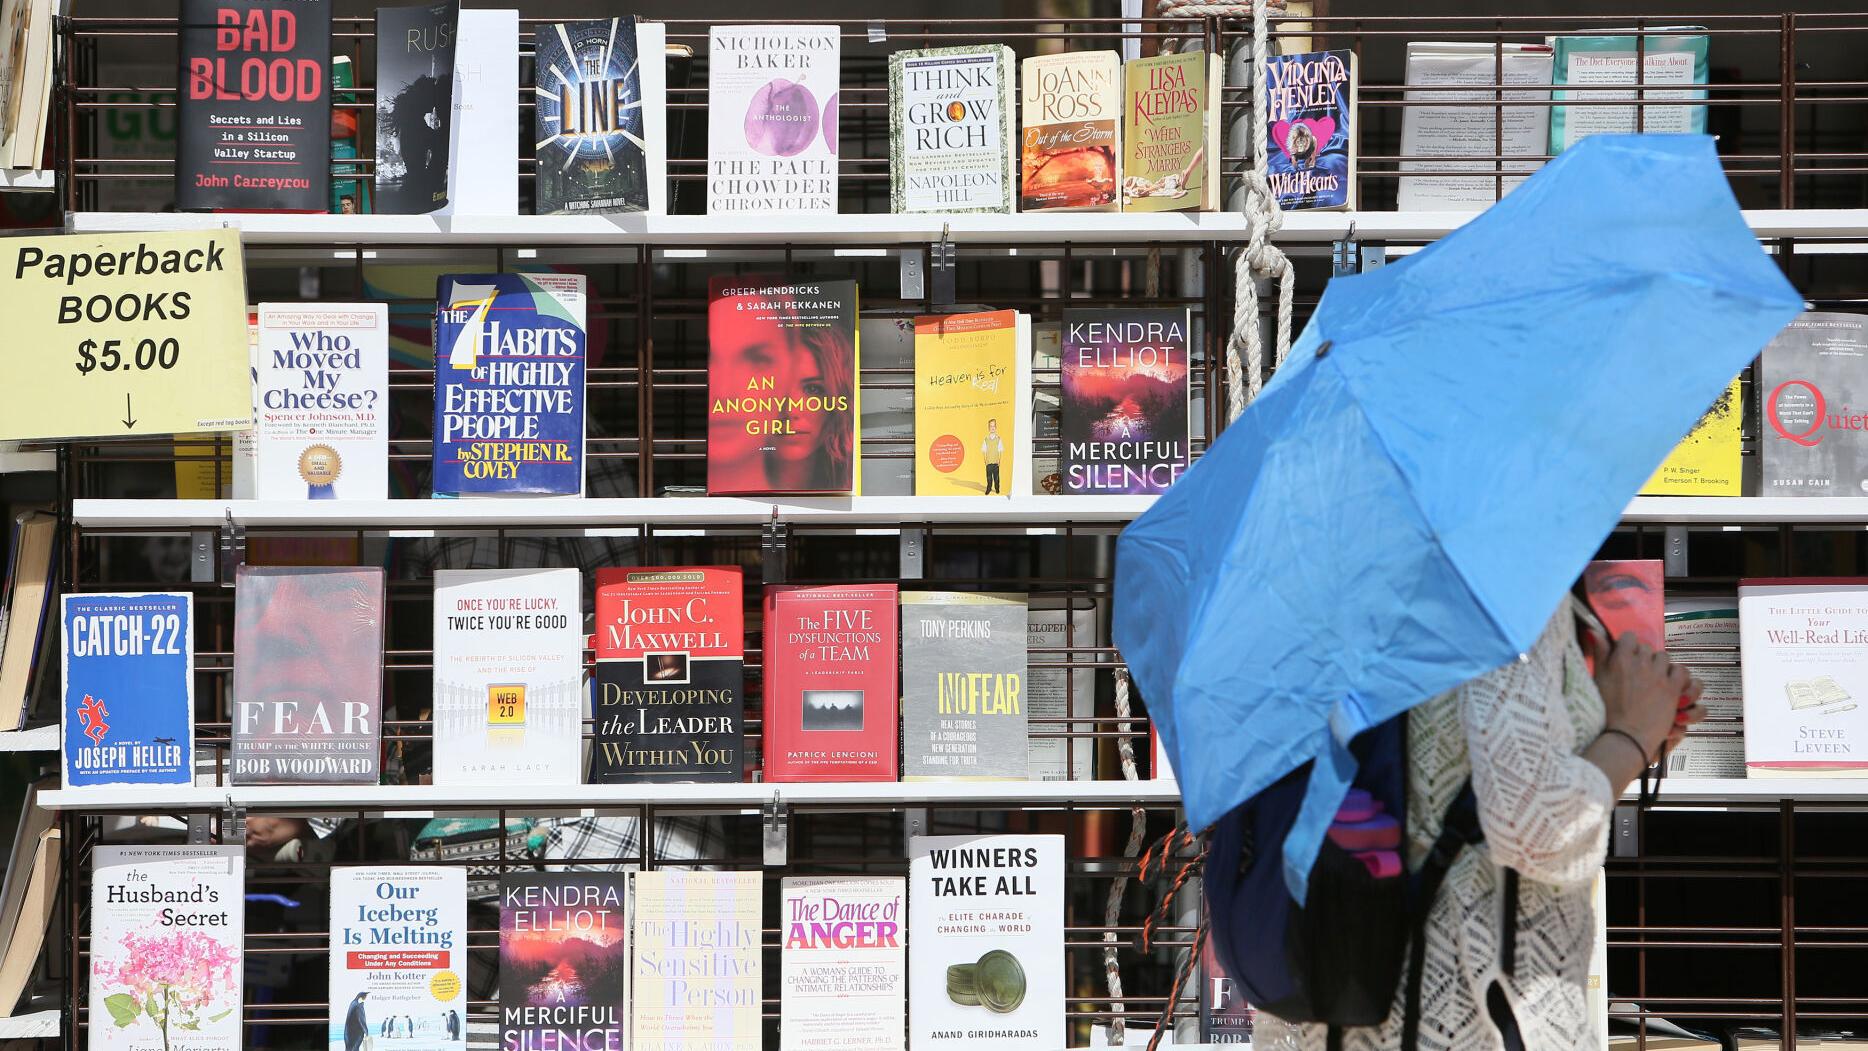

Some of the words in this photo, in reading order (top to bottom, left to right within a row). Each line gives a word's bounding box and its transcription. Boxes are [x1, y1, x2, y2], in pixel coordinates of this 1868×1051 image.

[217, 9, 296, 52] BAD
[715, 37, 834, 50] NICHOLSON
[738, 54, 811, 68] BAKER
[190, 57, 322, 102] BLOOD
[907, 67, 993, 91] THINK
[1150, 65, 1186, 91] LISA
[559, 77, 626, 136] LINE
[908, 99, 993, 125] GROW
[1134, 87, 1198, 127] KLEYPAS
[210, 114, 251, 125] Secrets
[256, 116, 274, 125] and
[278, 116, 302, 126] Lies
[753, 114, 811, 122] ANTHOLOGIST
[221, 132, 234, 142] in
[237, 134, 244, 142] a
[247, 131, 289, 142] Silicon
[916, 124, 989, 150] RICH
[1025, 127, 1048, 148] Out
[1048, 131, 1061, 149] of
[1060, 129, 1072, 143] the
[1072, 122, 1114, 143] Storm
[214, 148, 249, 160] Valley
[253, 149, 296, 160] Startup
[195, 174, 229, 188] John
[233, 174, 310, 190] Carreyrou
[910, 171, 997, 189] NAPOLEON
[1268, 171, 1299, 198] Wild
[1299, 170, 1339, 194] Hearts
[712, 198, 831, 210] CHRONICLES
[936, 188, 973, 203] HILL
[15, 240, 225, 285] Paperback
[722, 287, 756, 296] GREER
[759, 286, 820, 295] HENDRICKS
[57, 291, 192, 324] BOOKS
[442, 310, 468, 324] THE
[449, 280, 499, 369] 7
[1070, 321, 1183, 344] KENDRA
[290, 330, 351, 351] Who
[476, 320, 577, 356] HABITS
[75, 337, 180, 376] $5.00
[272, 348, 361, 369] Moved
[1079, 346, 1175, 368] ELLIOT
[303, 370, 341, 393] My
[471, 365, 489, 380] OF
[489, 362, 575, 386] HIGHLY
[746, 376, 775, 391] AN
[930, 373, 972, 386] Heaven
[976, 368, 985, 380] is
[989, 364, 1007, 378] for
[263, 388, 378, 409] Cheese?
[443, 383, 573, 414] EFFECTIVE
[711, 395, 848, 414] ANONYMOUS
[264, 412, 305, 422] Spencer
[307, 412, 353, 422] Johnson,
[355, 412, 377, 421] M.D.
[1767, 379, 1868, 447] Quiet
[442, 414, 540, 443] PEOPLE
[745, 419, 797, 436] GIRL
[1070, 441, 1185, 460] MERCIFUL
[1700, 477, 1729, 486] Brooking
[1808, 478, 1830, 486] CAIN
[457, 599, 483, 611] ONCE
[486, 598, 521, 610] YOU'RE
[525, 598, 558, 610] LUCKY,
[447, 616, 484, 630] TWICE
[488, 615, 531, 629] YOU'RE
[535, 614, 567, 629] GOOD
[797, 617, 820, 629] The
[823, 609, 873, 630] FIVE
[920, 619, 946, 638] TONY
[948, 619, 991, 638] PERKINS
[1808, 618, 1831, 627] Your
[73, 614, 180, 657] CATCH-22
[789, 632, 881, 644] DYSFUNCTIONS
[1767, 629, 1839, 644] Well-Read
[1843, 629, 1868, 644] Life
[799, 649, 809, 661] of
[818, 645, 870, 661] TEAM
[497, 692, 517, 704] WEB
[237, 701, 372, 734] FEAR
[499, 705, 514, 717] 2.0
[601, 714, 635, 736] the
[237, 742, 272, 750] TRUMP
[301, 742, 335, 750] WHITE
[338, 742, 372, 750] HOUSE
[74, 746, 126, 769] JOSEPH
[133, 745, 181, 767] HELLER
[236, 758, 270, 774] BOB
[276, 758, 372, 774] WOODWARD
[930, 848, 1038, 869] WINNERS
[126, 869, 148, 881] the
[931, 876, 987, 896] TAKE
[994, 875, 1037, 896] ALL
[106, 884, 219, 903] Husband's
[376, 882, 420, 899] Our
[506, 886, 620, 907] KENDRA
[161, 908, 228, 926] Secret
[358, 903, 438, 926] Iceberg
[787, 895, 819, 921] The
[822, 897, 880, 921] Dance
[883, 895, 900, 921] of
[949, 913, 974, 921] ELITE
[979, 912, 1024, 921] CHARADE
[515, 909, 611, 932] ELLIOT
[343, 927, 362, 945] Is
[369, 926, 453, 949] Melting
[641, 921, 670, 936] The
[672, 921, 756, 950] Highly
[785, 921, 900, 949] ANGER
[640, 951, 757, 976] Sensitive
[366, 972, 391, 981] John
[394, 971, 427, 980] Kotter
[787, 975, 831, 984] CHANGING
[831, 975, 848, 984] THE
[848, 974, 888, 983] PATTERNS
[888, 974, 900, 983] OF
[672, 980, 754, 1006] Person
[795, 984, 833, 992] INTIMATE
[834, 982, 894, 992] RELATIONSHIPS
[1210, 1017, 1245, 1026] TRUMP
[504, 1028, 620, 1051] SILENCE
[931, 1031, 963, 1039] ANAND
[968, 1029, 1039, 1039] GIRIDHARADAS
